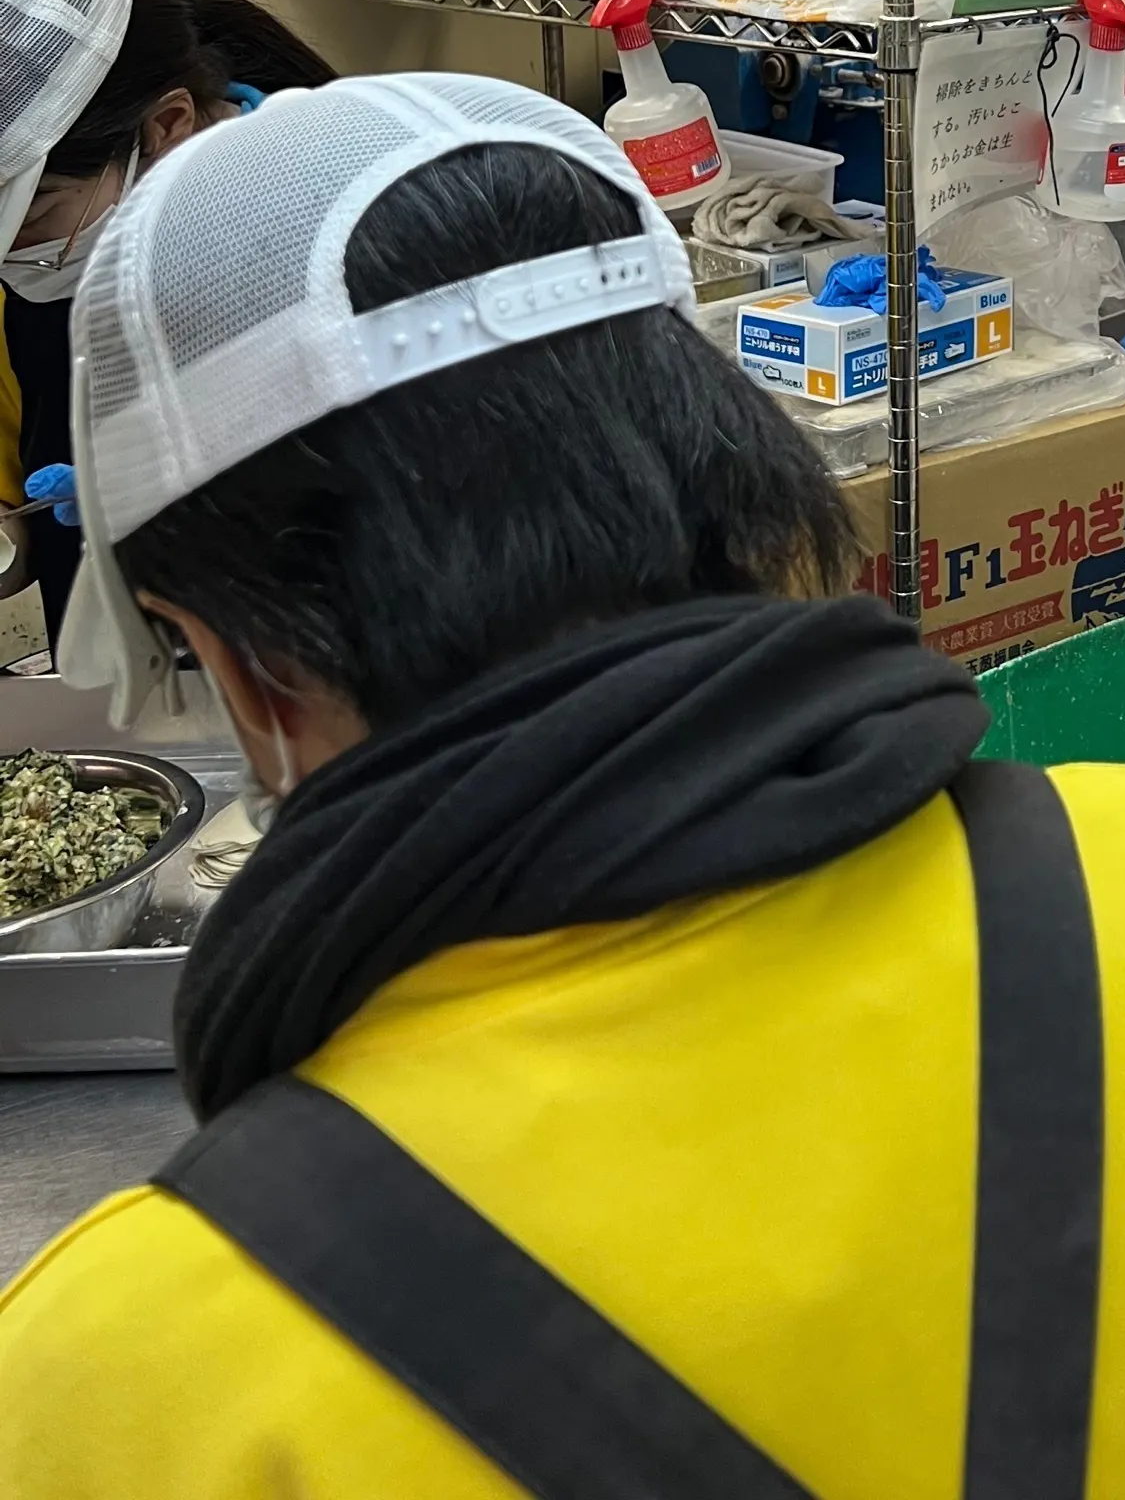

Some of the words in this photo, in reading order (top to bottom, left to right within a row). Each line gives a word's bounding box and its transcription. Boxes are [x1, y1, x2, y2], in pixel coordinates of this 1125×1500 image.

[936, 70, 1033, 103] 掃除をきちんと
[931, 132, 1014, 175] ろからお金は生
[930, 181, 971, 213] まれない。
[980, 292, 1007, 309] Blue
[989, 321, 1001, 343] L
[743, 358, 763, 370] Blue
[818, 376, 827, 391] L
